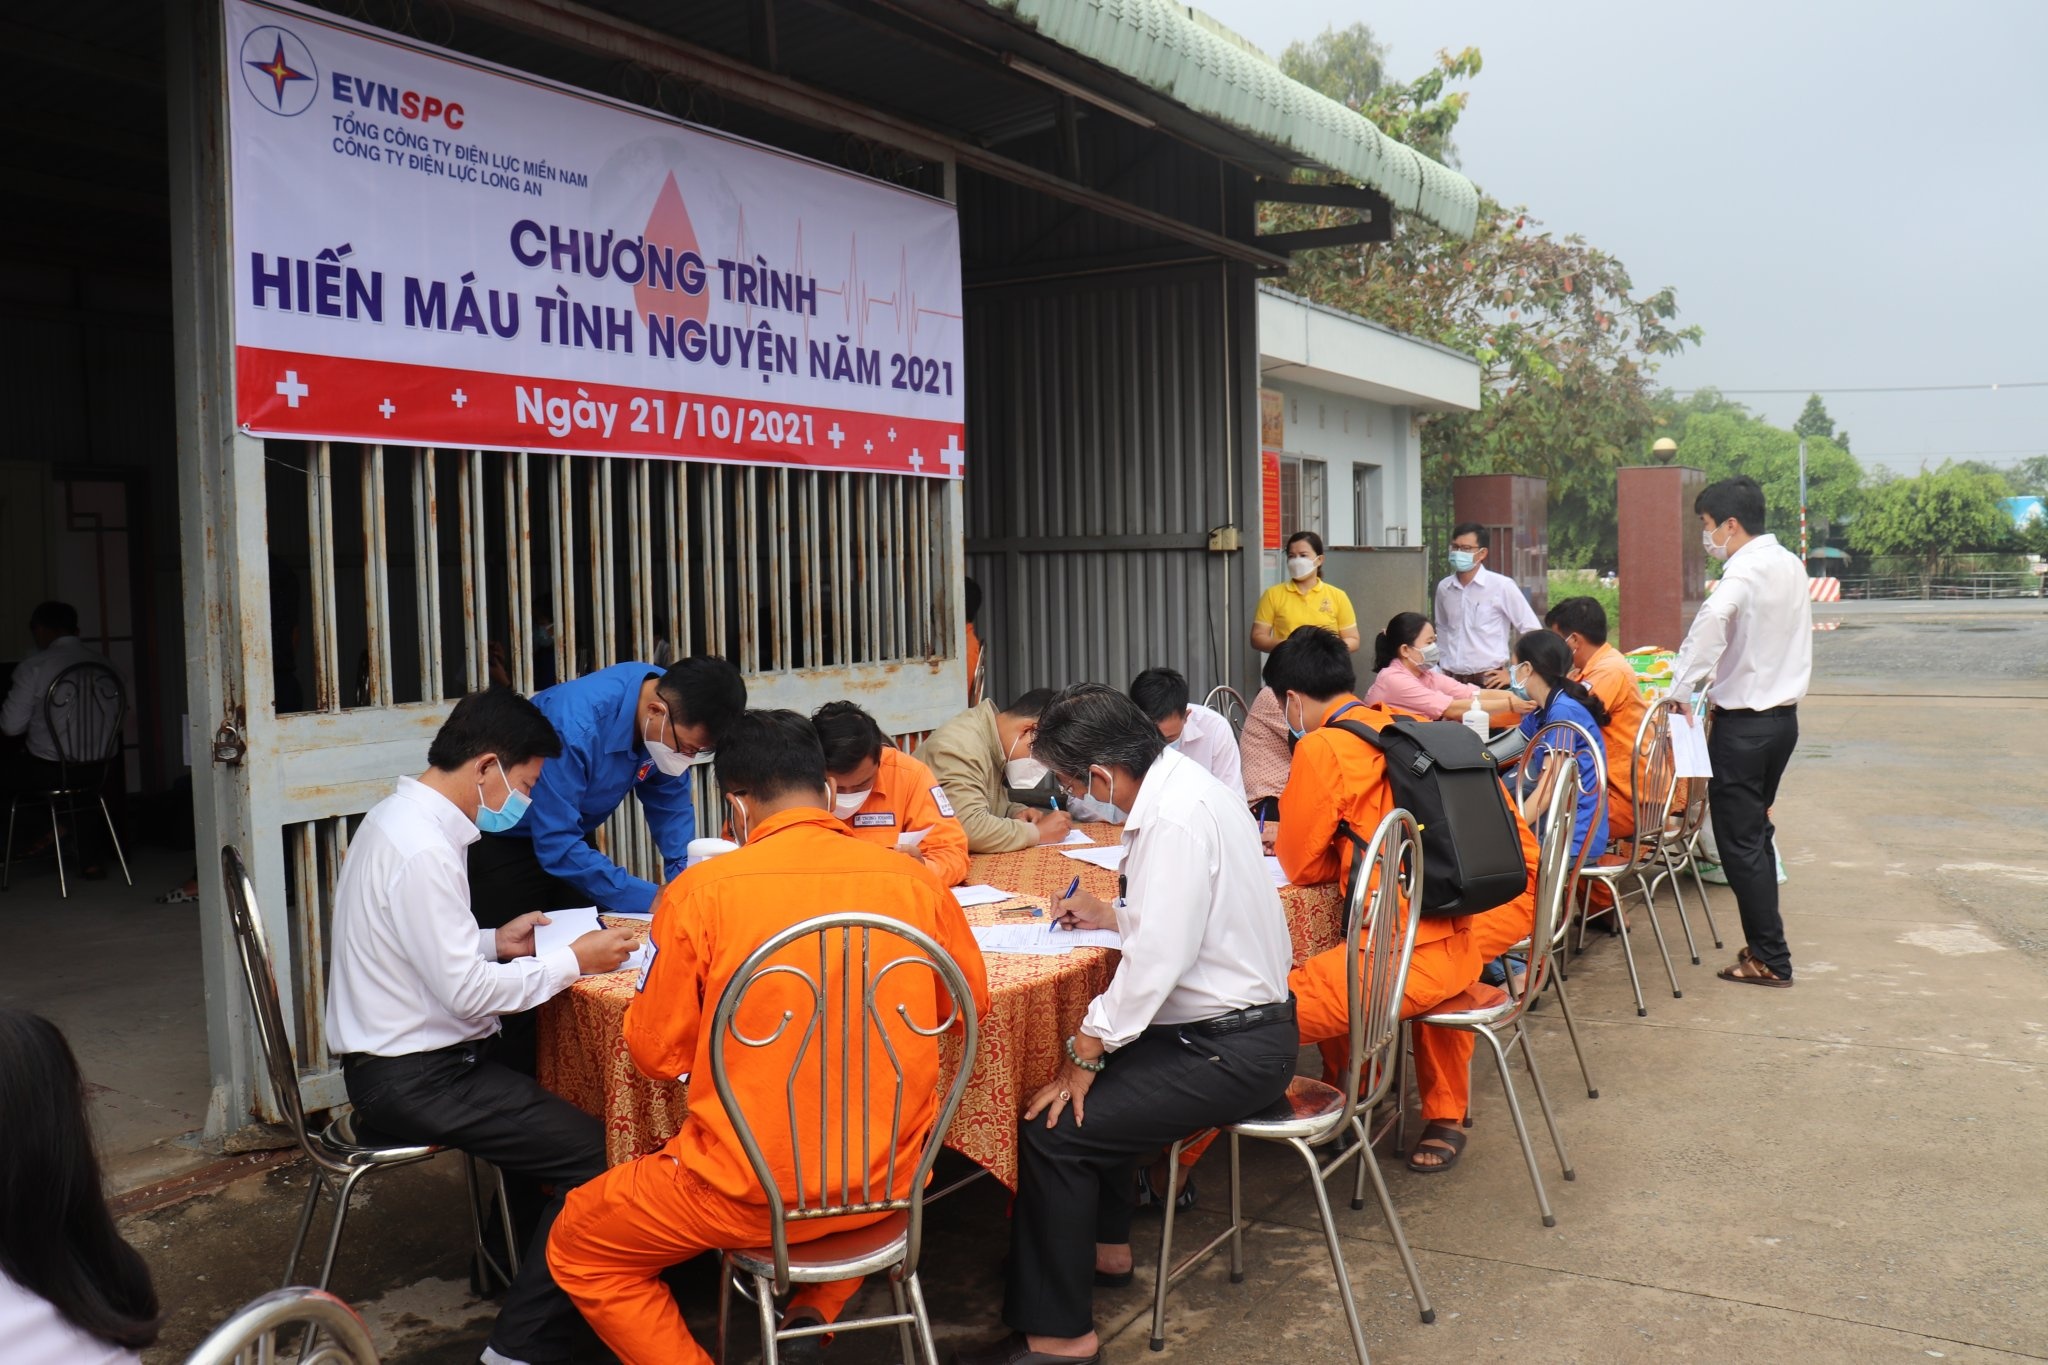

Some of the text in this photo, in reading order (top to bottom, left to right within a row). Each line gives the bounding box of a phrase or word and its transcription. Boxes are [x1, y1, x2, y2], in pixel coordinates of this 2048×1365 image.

[332, 72, 464, 130] EVNSPC
[332, 110, 379, 140] TỔNG
[383, 126, 429, 151] CÔNG
[432, 139, 451, 156] TY
[455, 145, 488, 166] ĐIỆN
[493, 153, 520, 173] LỰC
[559, 169, 588, 188] NAM
[333, 136, 542, 197] CÔNG TY ĐIỆN LỰC LONG AN
[510, 219, 817, 316] CHƯƠNG TRÌNH
[251, 243, 953, 396] HIẾN MÁU TÌNH NGUYỆN NĂM 2021
[515, 385, 814, 446] Ngày 21/10/2021
